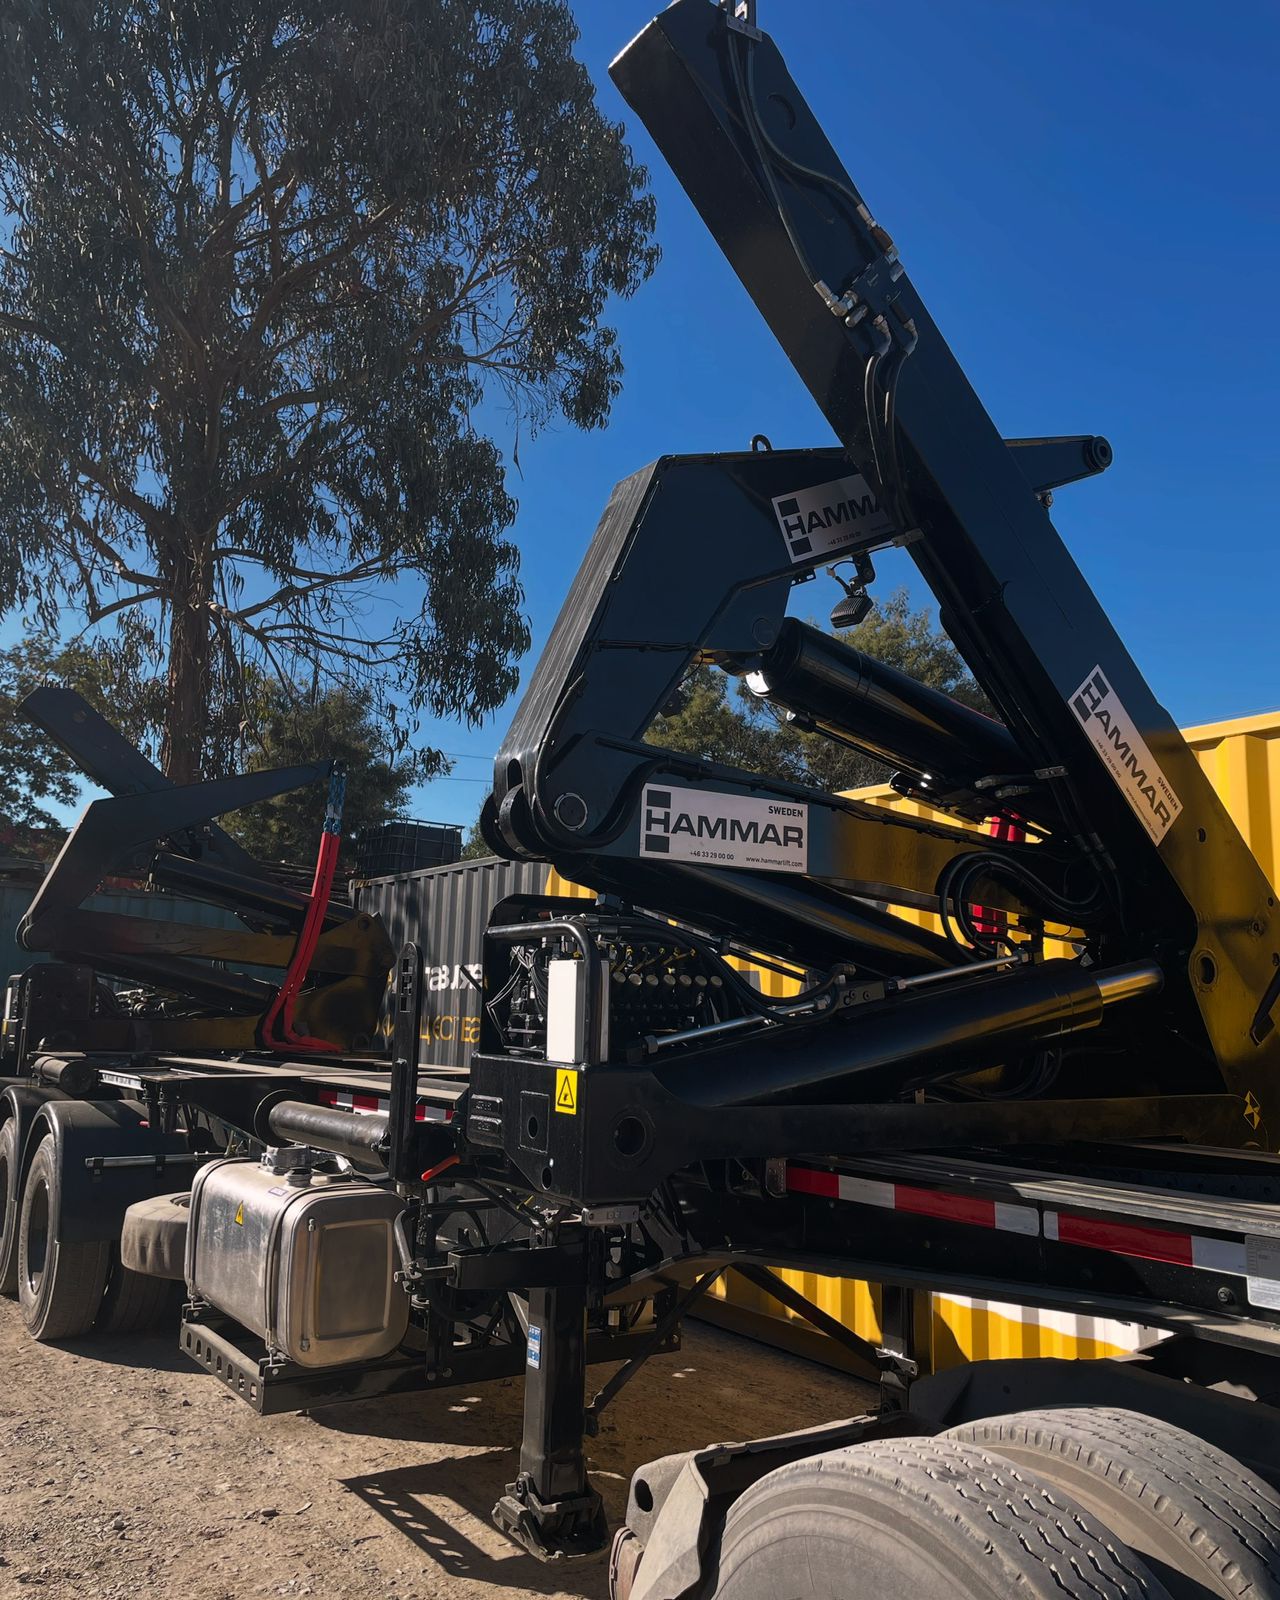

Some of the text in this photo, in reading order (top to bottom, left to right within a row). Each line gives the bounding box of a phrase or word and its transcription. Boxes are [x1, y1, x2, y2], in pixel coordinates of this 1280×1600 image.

[783, 494, 881, 539] HAMM
[1081, 682, 1172, 828] HAMMAR
[768, 805, 804, 818] SWEDEN
[1156, 775, 1178, 811] SWEDEN
[646, 808, 803, 848] HAMMAR
[746, 856, 803, 867] www.hammarlift.com
